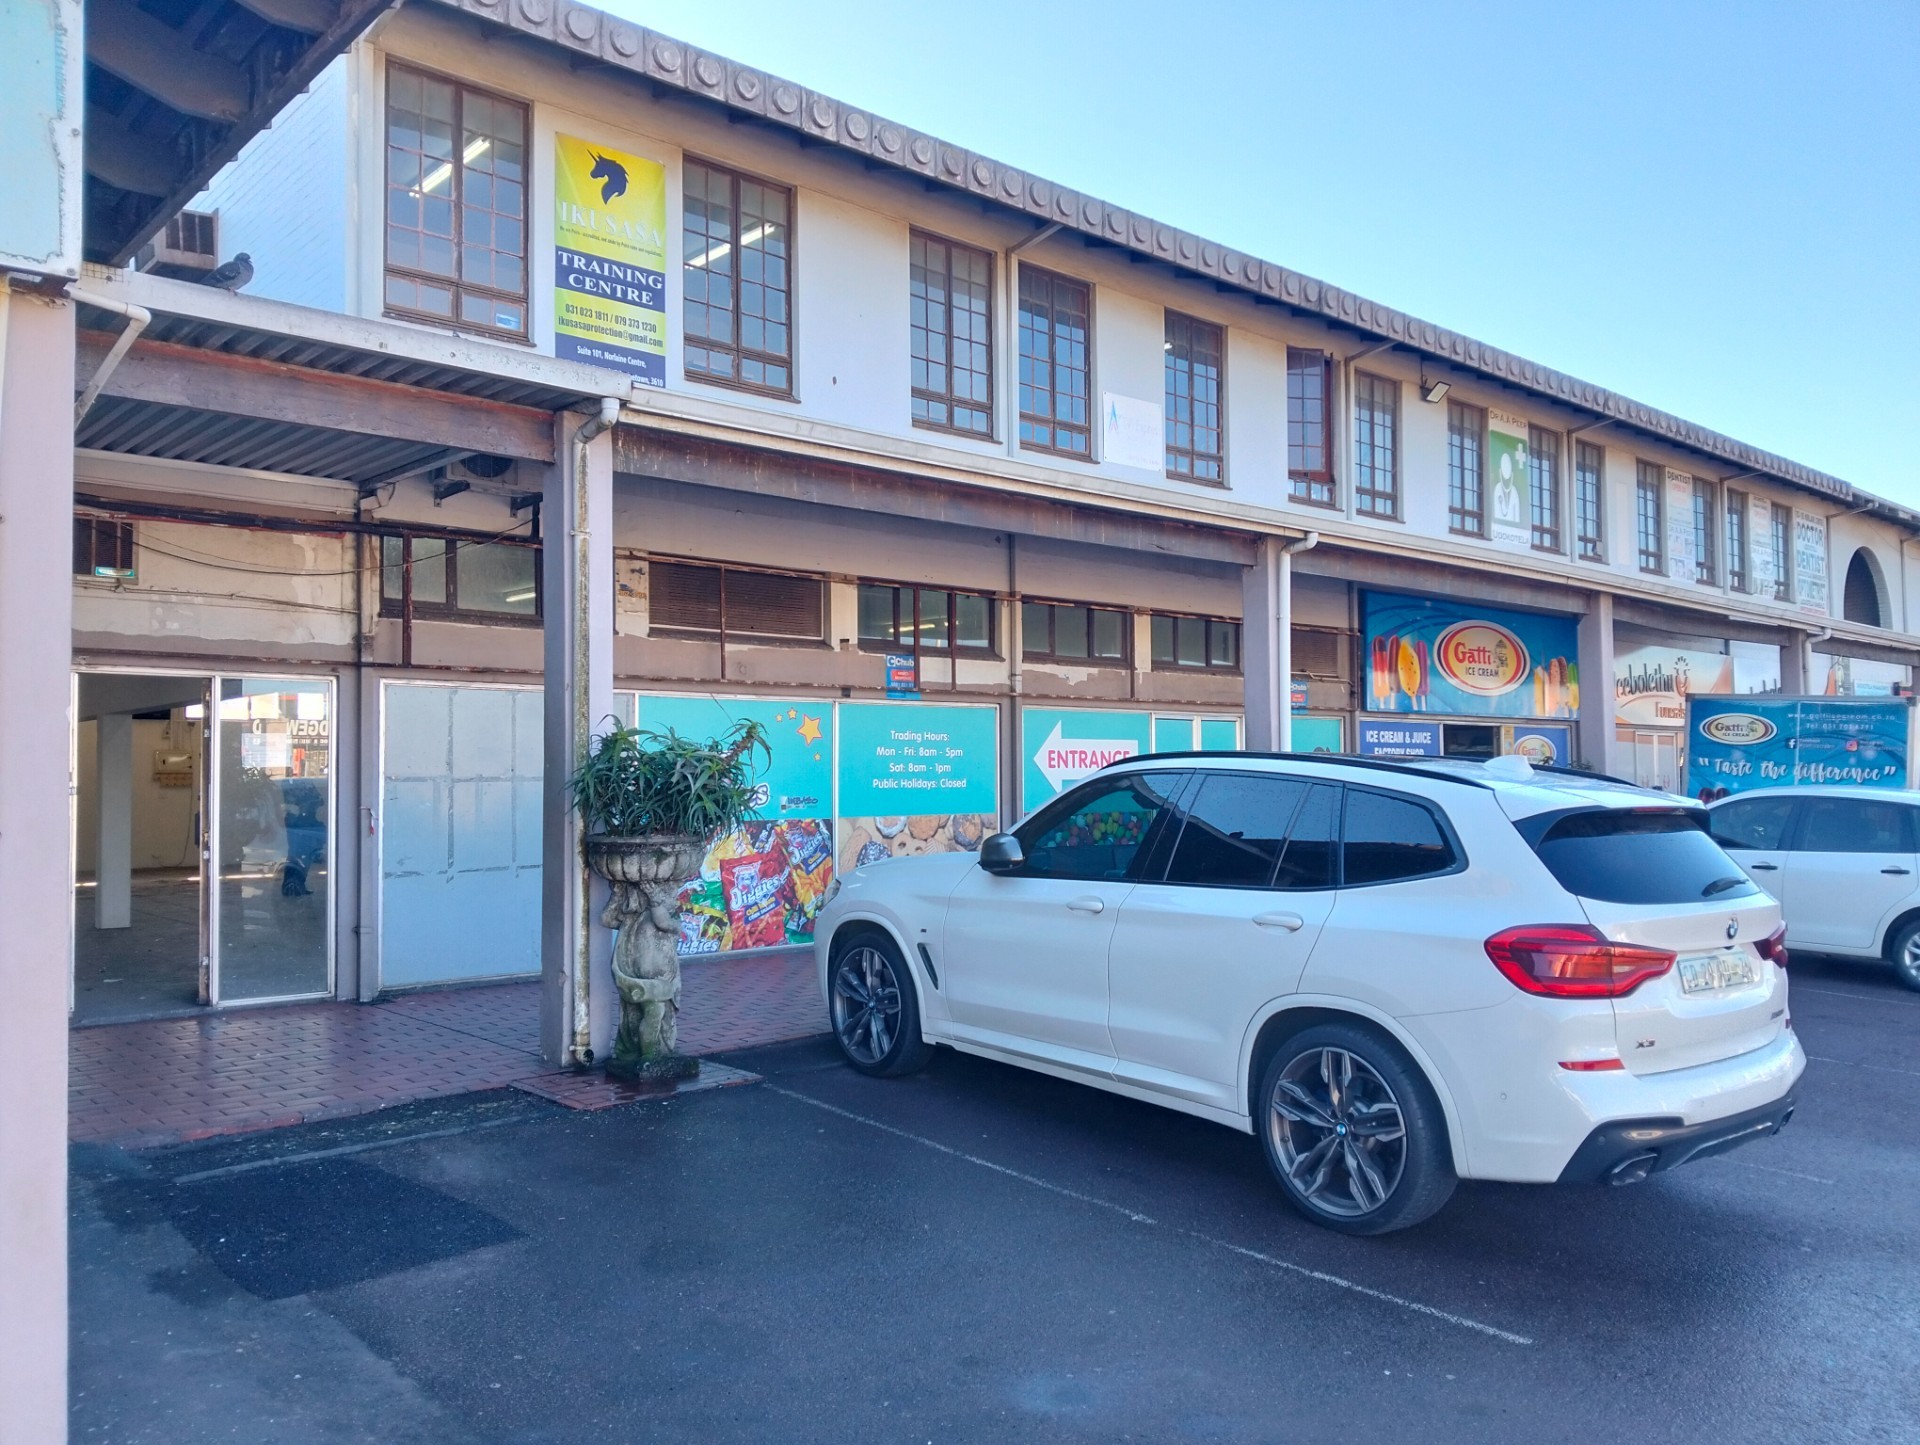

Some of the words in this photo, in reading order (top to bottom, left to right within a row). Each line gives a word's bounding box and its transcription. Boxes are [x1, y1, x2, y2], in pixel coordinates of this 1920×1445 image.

[560, 201, 662, 248] IKUSASA
[558, 251, 663, 290] TRAINING
[568, 273, 654, 306] CENTRE
[565, 303, 578, 314] 031
[580, 307, 593, 319] 023
[594, 310, 609, 322] 1811
[614, 314, 627, 327] 079
[628, 318, 640, 330] 373
[641, 321, 657, 333] 1230
[576, 345, 592, 357] Suite
[650, 377, 664, 387] 3610
[1666, 470, 1691, 485] DENTIST
[1796, 521, 1825, 547] DOCTOR
[1796, 549, 1825, 576] DENTIST
[1454, 641, 1492, 665] Gatti
[1465, 666, 1476, 676] ICE
[1477, 667, 1499, 677] CREAM
[890, 730, 922, 743] Trading
[923, 731, 950, 741] Hours:
[1366, 730, 1379, 743] ICE
[1379, 730, 1404, 744] CREAM
[1405, 731, 1411, 744] &
[1411, 731, 1432, 744] JUICE
[876, 746, 896, 756] Mon
[904, 747, 917, 756] Fri:
[918, 747, 937, 757] 8am
[945, 747, 964, 758] 5pm
[889, 762, 906, 773] Sat:
[908, 762, 927, 772] 8am
[935, 763, 951, 774] 1pm
[872, 778, 899, 789] Public
[900, 778, 938, 790] Holidays:
[939, 778, 967, 788] Closed
[677, 940, 719, 954] iggies
